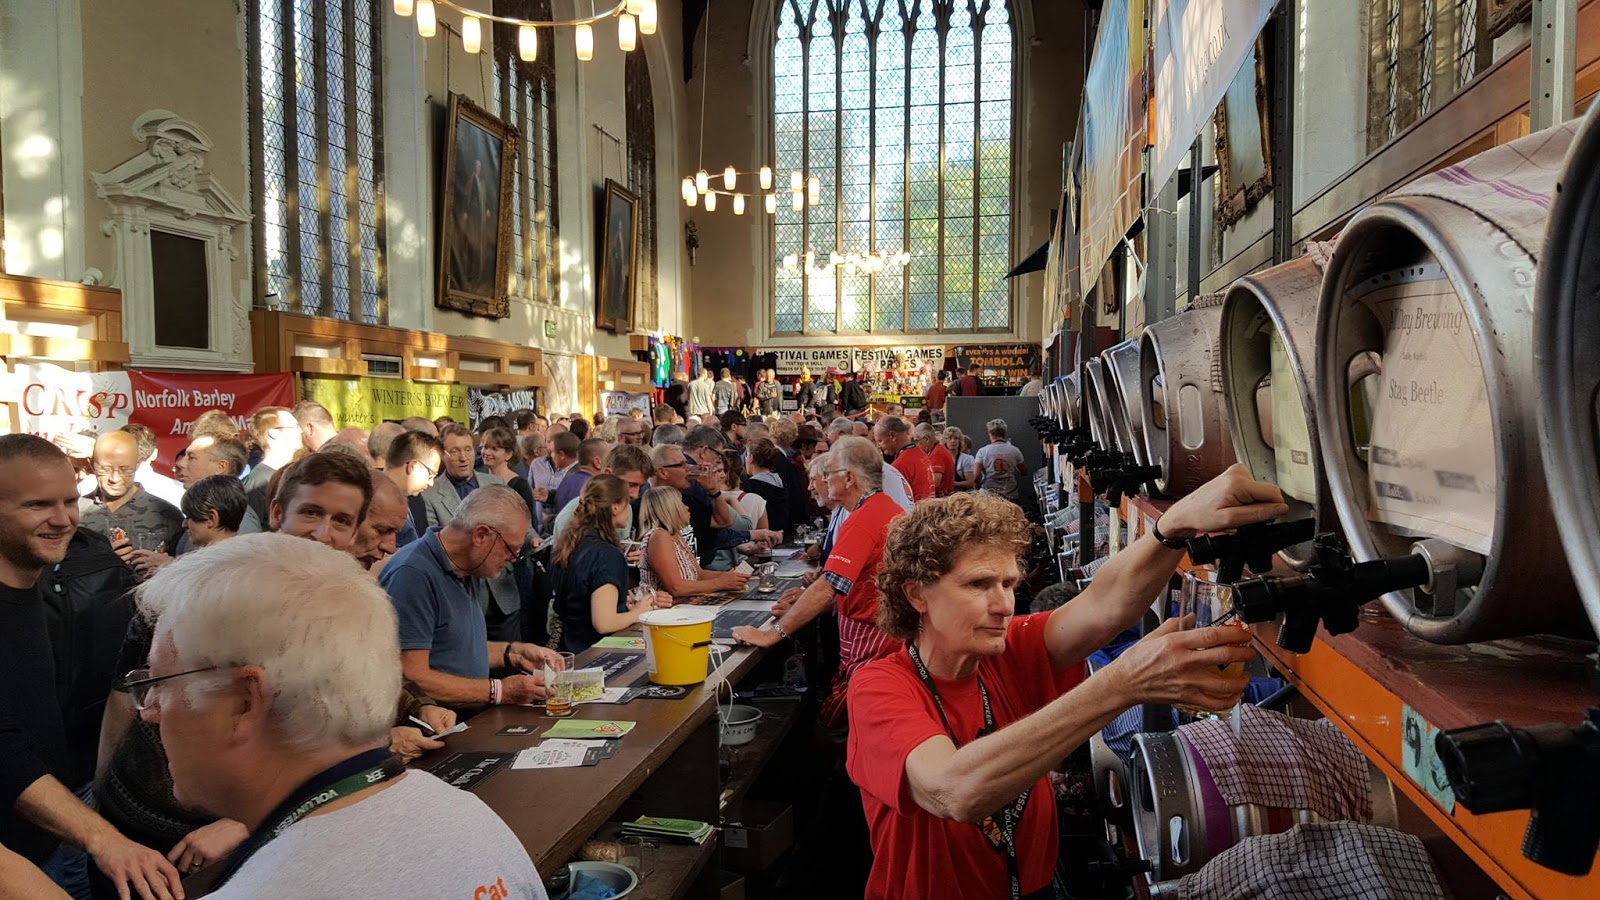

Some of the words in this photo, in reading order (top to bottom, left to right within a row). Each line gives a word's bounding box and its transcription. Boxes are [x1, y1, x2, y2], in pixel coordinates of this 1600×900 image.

[1397, 308, 1413, 335] Day
[1415, 304, 1463, 335] Brewing
[774, 350, 808, 360] STIVAL
[812, 350, 849, 360] GAMES
[854, 349, 897, 361] FESTIVA
[969, 356, 1024, 367] TOMBOLA
[1007, 368, 1028, 377] WIN
[23, 384, 128, 418] CRISP
[135, 389, 189, 408] Norfolk
[193, 389, 235, 409] Barley
[372, 388, 422, 407] WINTER'S
[425, 393, 465, 409] BREWER
[1389, 379, 1408, 406] Stag
[1411, 381, 1444, 405] Beetle
[336, 411, 375, 424] winter's
[273, 789, 340, 836] VOLUNTEER
[473, 876, 508, 900] Cat
